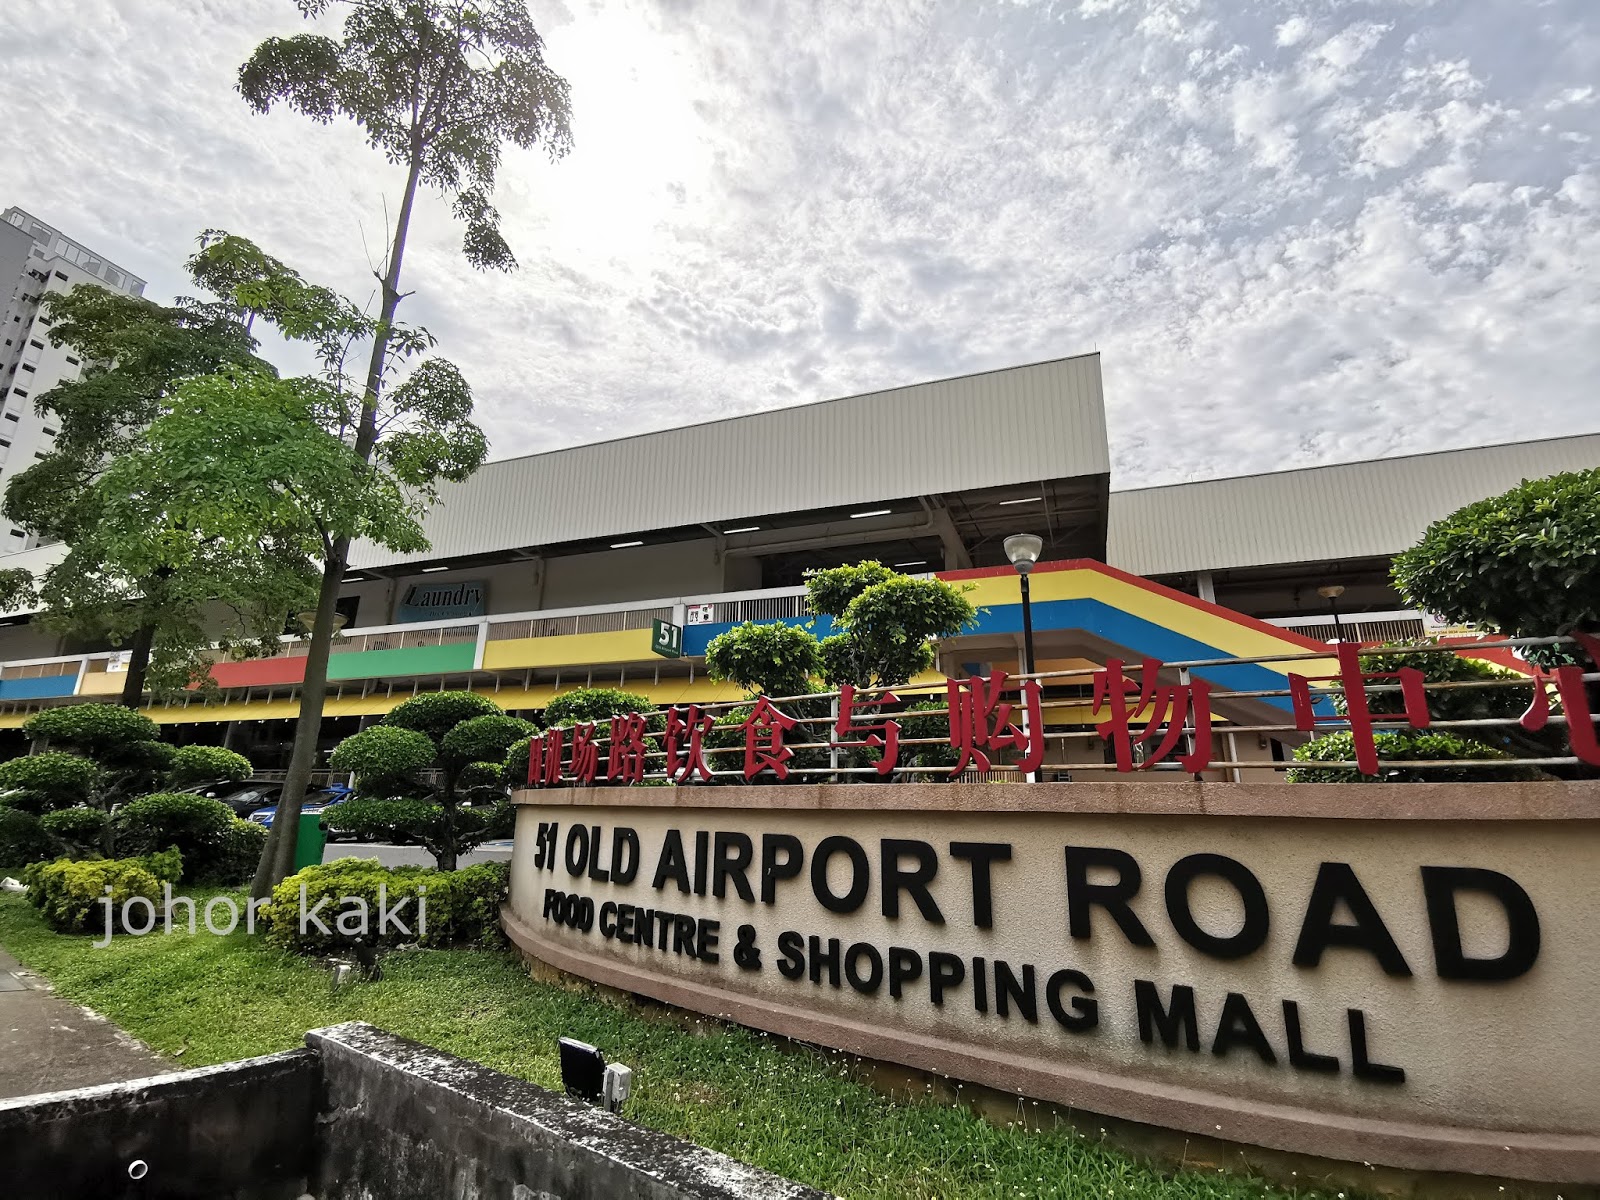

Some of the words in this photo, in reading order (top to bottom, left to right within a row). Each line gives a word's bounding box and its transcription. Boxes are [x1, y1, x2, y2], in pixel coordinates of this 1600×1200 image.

[405, 584, 482, 609] Laundry
[659, 622, 678, 649] 51
[535, 822, 559, 870] 51
[565, 824, 640, 885] OLD
[652, 829, 1012, 929] AIRPORT
[1065, 845, 1541, 981] ROAD
[543, 888, 594, 933] FOOD
[599, 901, 720, 963] CENTRE
[733, 924, 762, 970] &
[776, 931, 1099, 1031] SHOPPING
[1134, 980, 1405, 1083] MALL
